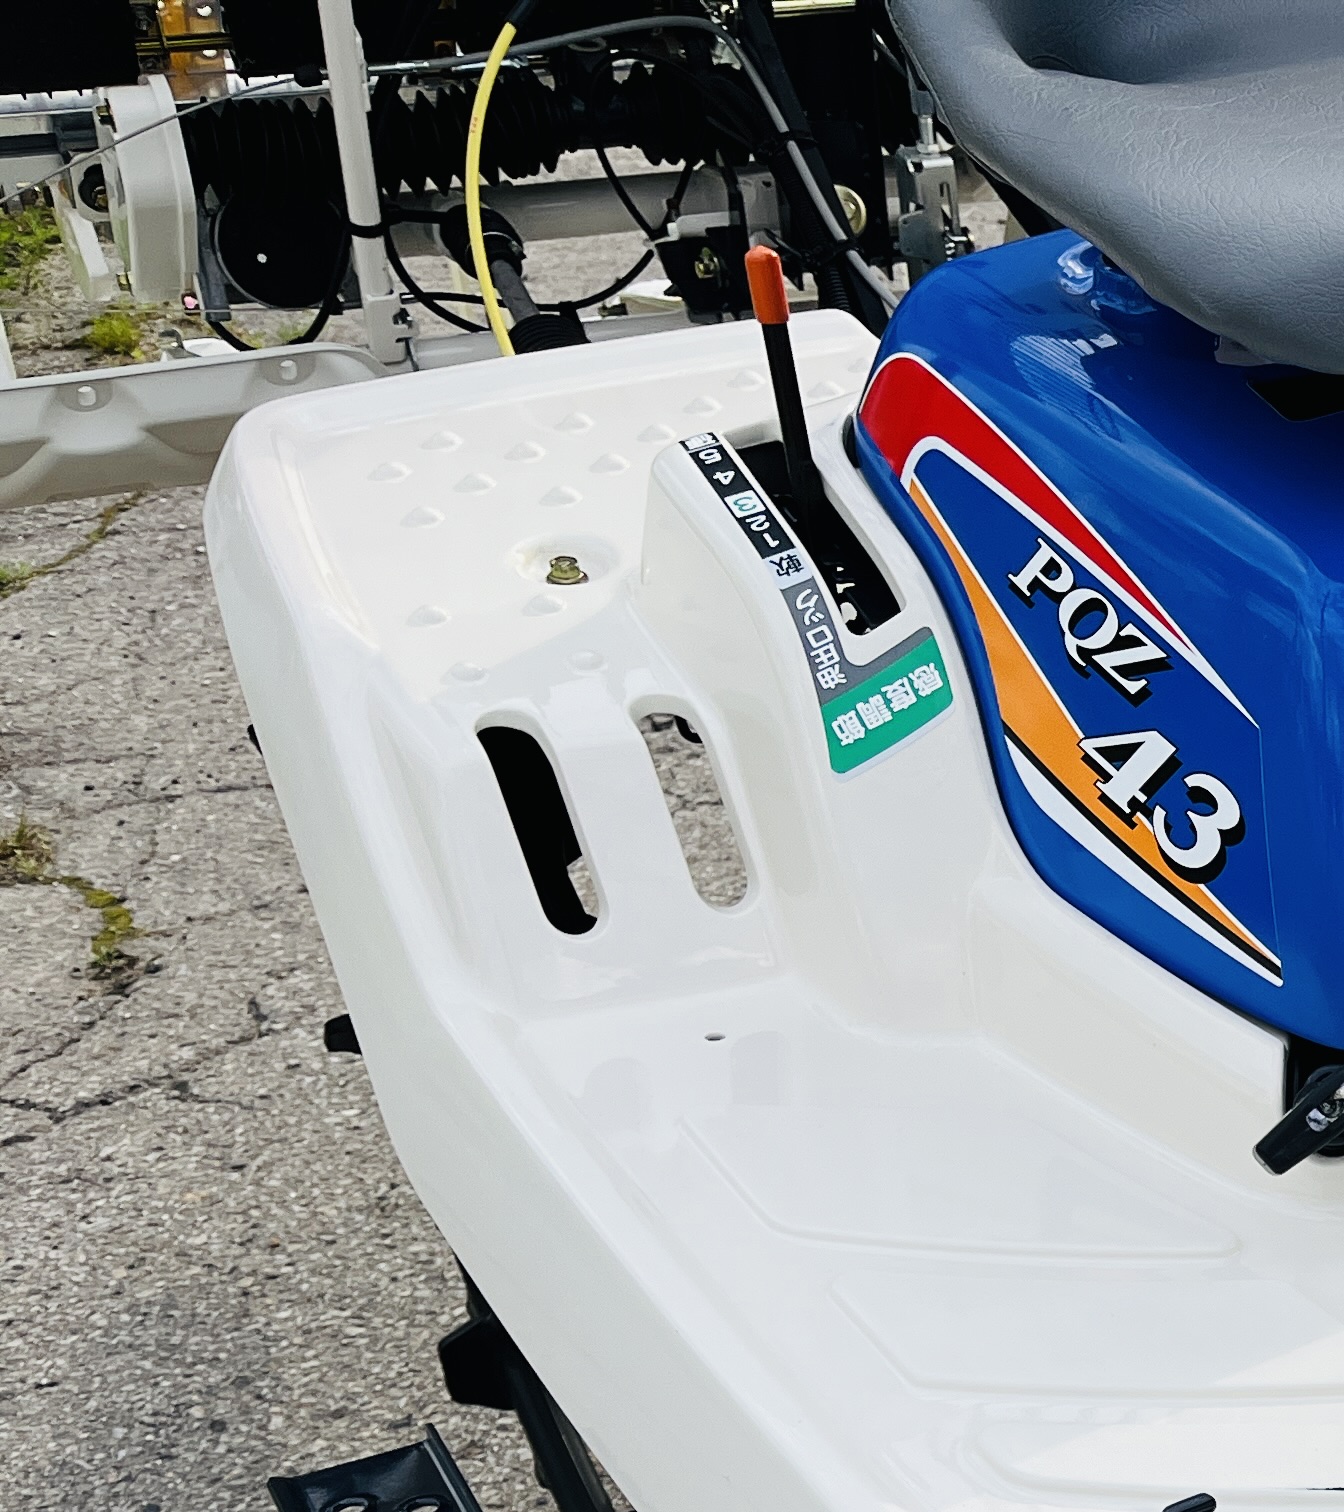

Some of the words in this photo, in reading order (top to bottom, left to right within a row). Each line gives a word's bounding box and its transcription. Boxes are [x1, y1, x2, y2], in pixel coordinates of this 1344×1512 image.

[699, 448, 722, 465] 5
[713, 470, 735, 485] 4
[733, 496, 757, 511] 3
[745, 514, 770, 532] 2
[763, 533, 780, 548] 1
[769, 553, 804, 577] 軟
[1007, 538, 1171, 704] PQZ
[831, 661, 943, 746] 感度調節
[1079, 728, 1246, 885] 43
